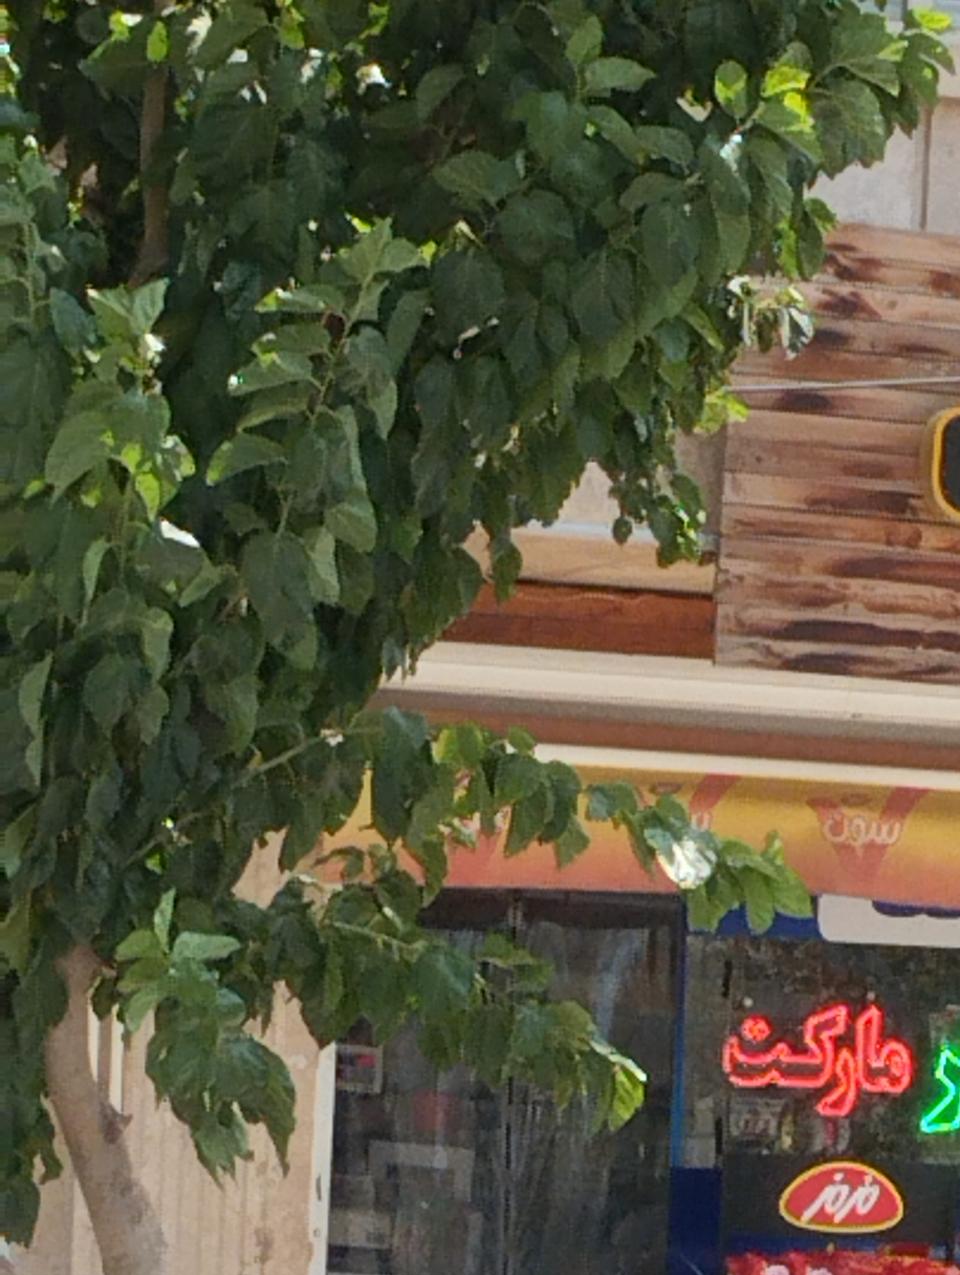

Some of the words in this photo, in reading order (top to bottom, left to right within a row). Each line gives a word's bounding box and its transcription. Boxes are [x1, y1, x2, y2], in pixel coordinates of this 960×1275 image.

[823, 809, 902, 844] سون
[723, 1003, 914, 1118] مارکت
[801, 1172, 881, 1224] مزمز
